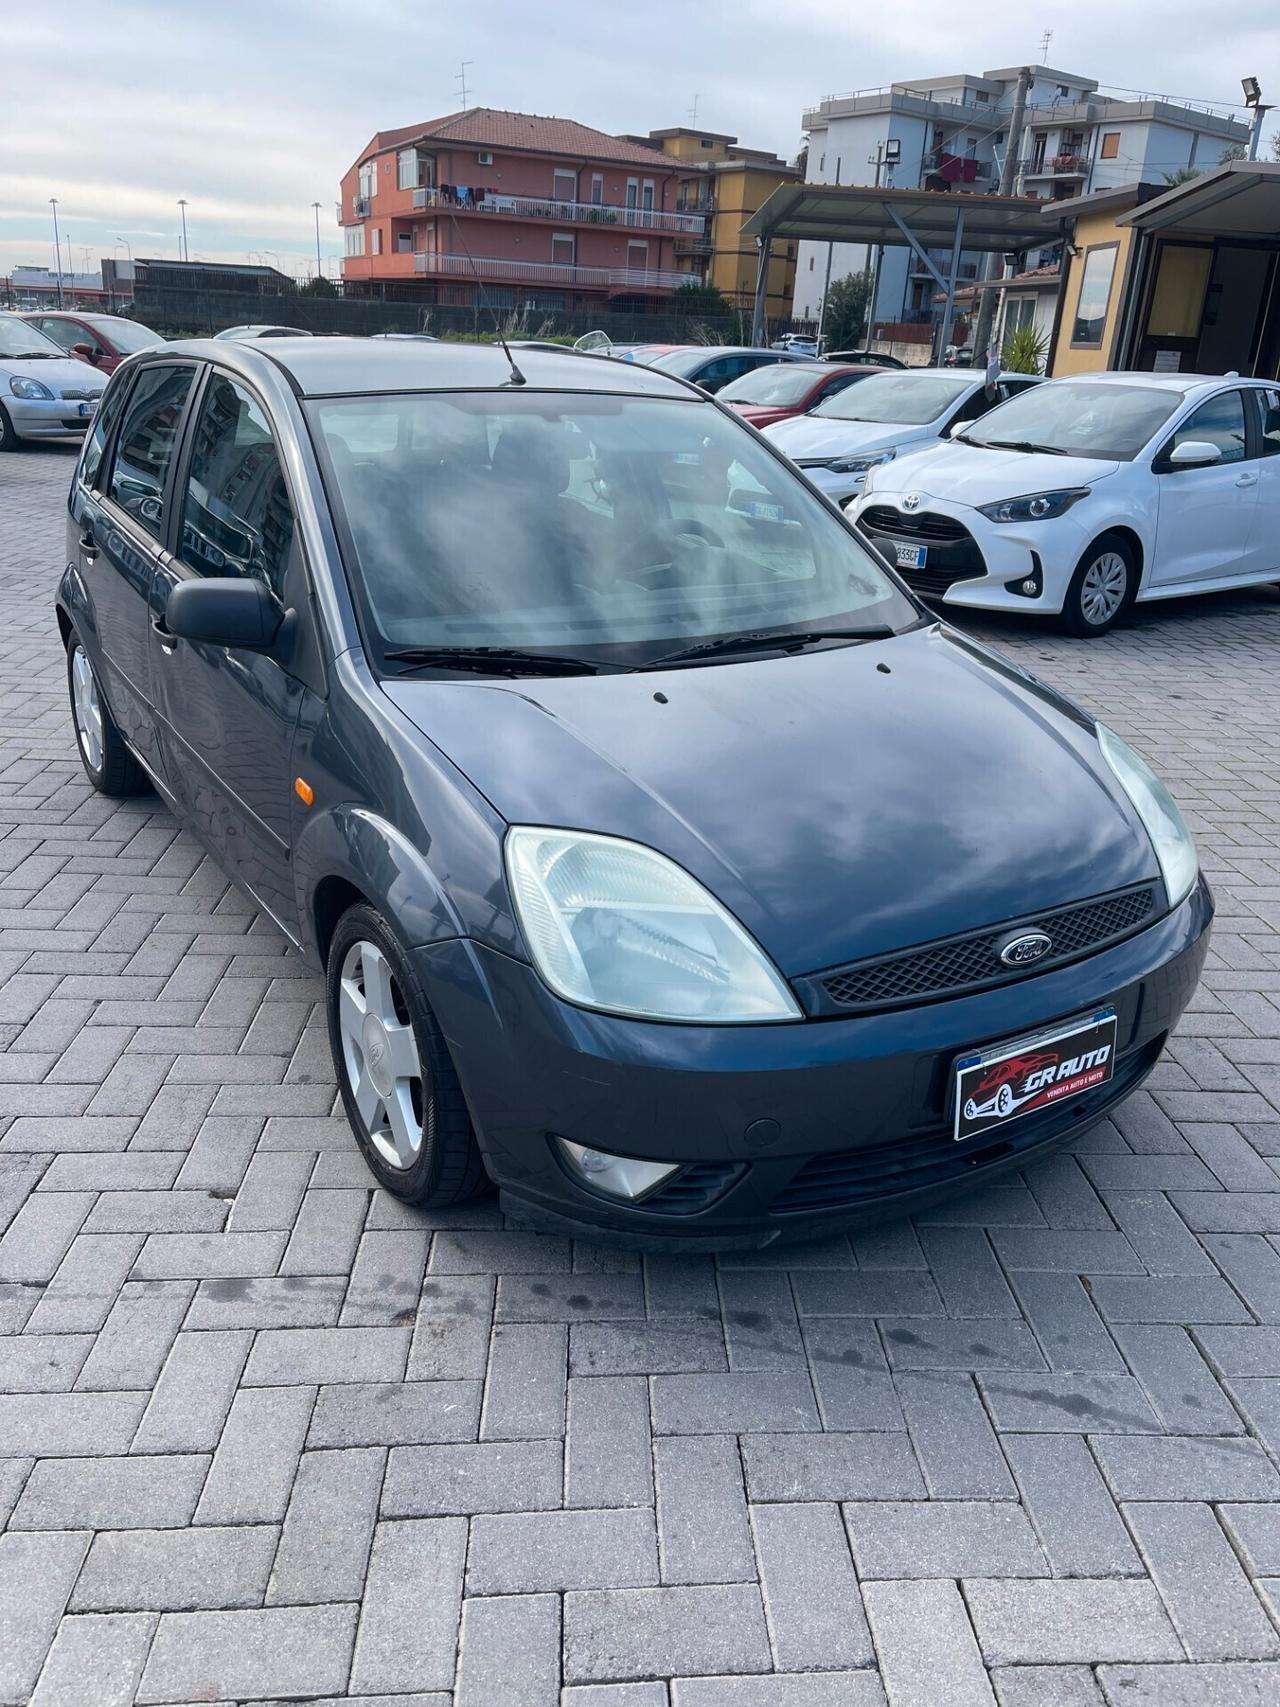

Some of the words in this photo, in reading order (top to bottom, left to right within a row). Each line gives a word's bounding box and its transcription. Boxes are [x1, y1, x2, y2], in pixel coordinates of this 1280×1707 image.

[1015, 940, 1043, 961] Ford
[1022, 1065, 1058, 1093] GR
[1056, 1044, 1112, 1081] AUTO
[1046, 1084, 1070, 1098] VENDITA
[1069, 1078, 1084, 1090] AUTO
[1088, 1071, 1104, 1082] MOTO
